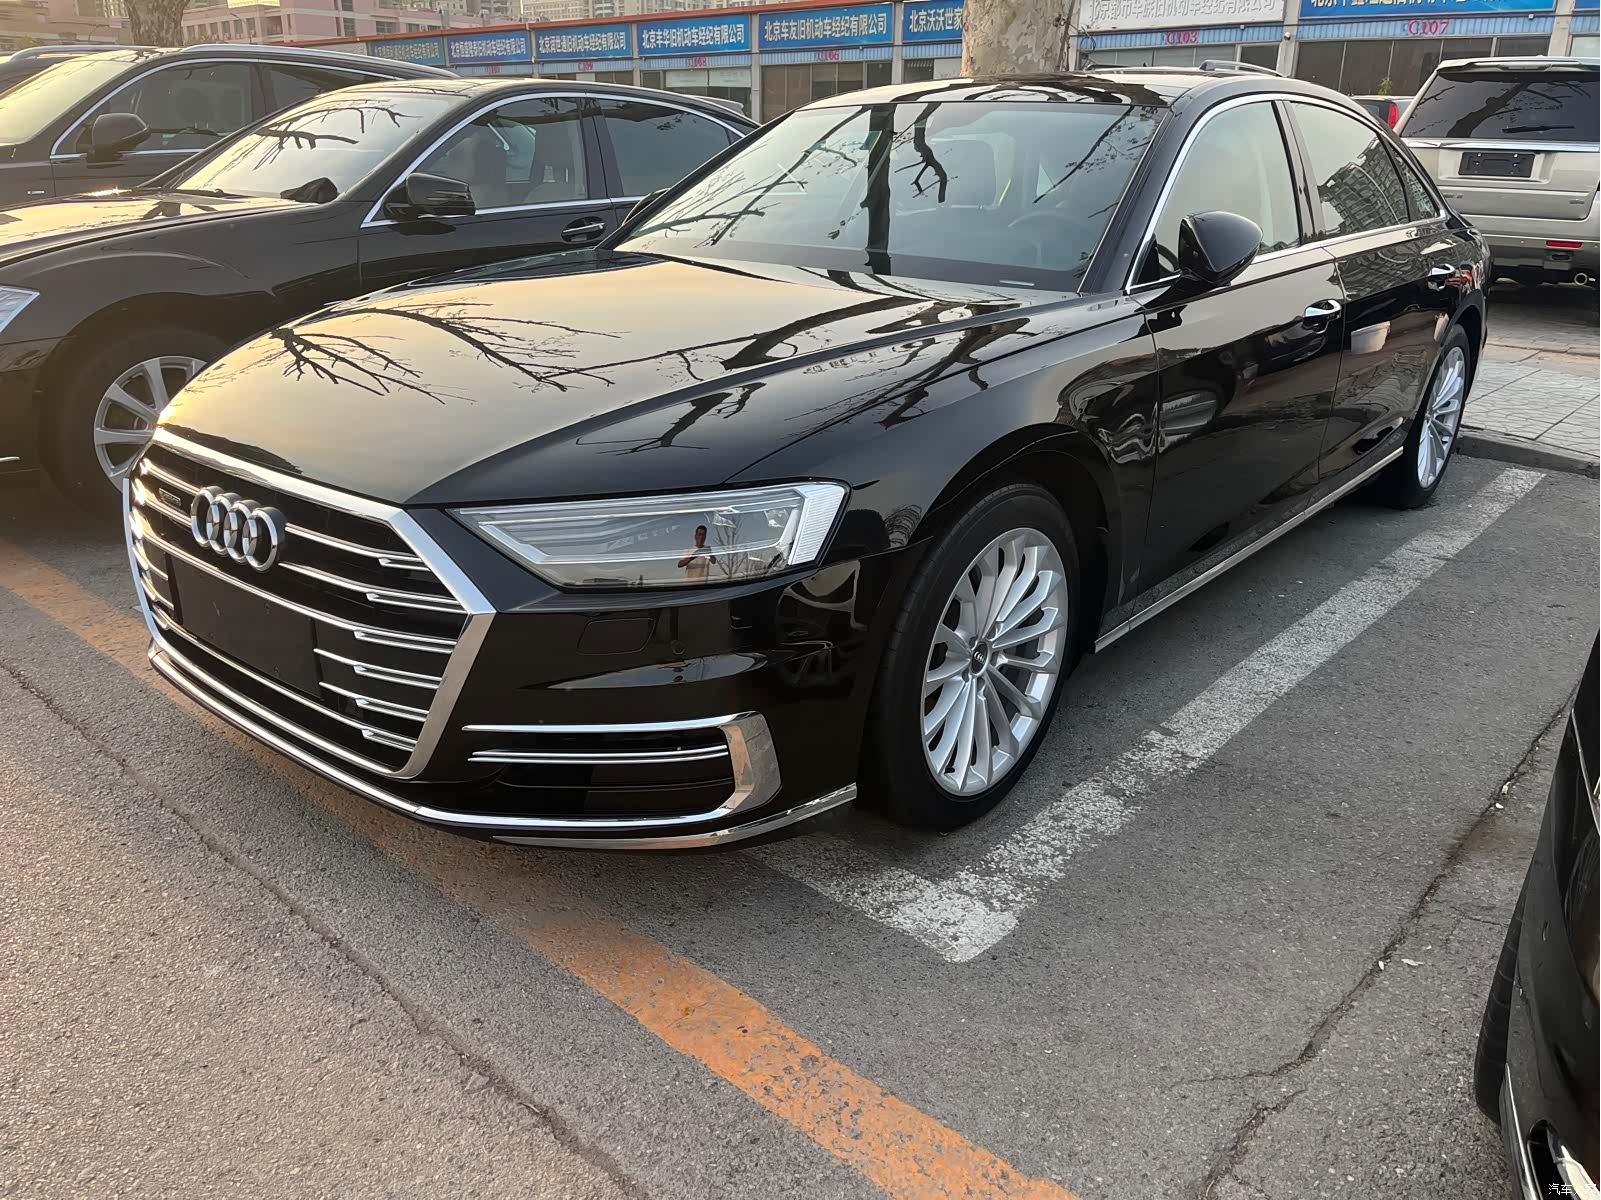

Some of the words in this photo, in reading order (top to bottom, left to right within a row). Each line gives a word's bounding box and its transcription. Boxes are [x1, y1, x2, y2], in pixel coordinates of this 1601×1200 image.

[642, 24, 745, 48] 北京丰华旧机动车经纪有限公司
[764, 13, 887, 42] 北京车友旧机动车经纪有限公司
[1407, 18, 1449, 35] C107
[1166, 31, 1198, 44] C103
